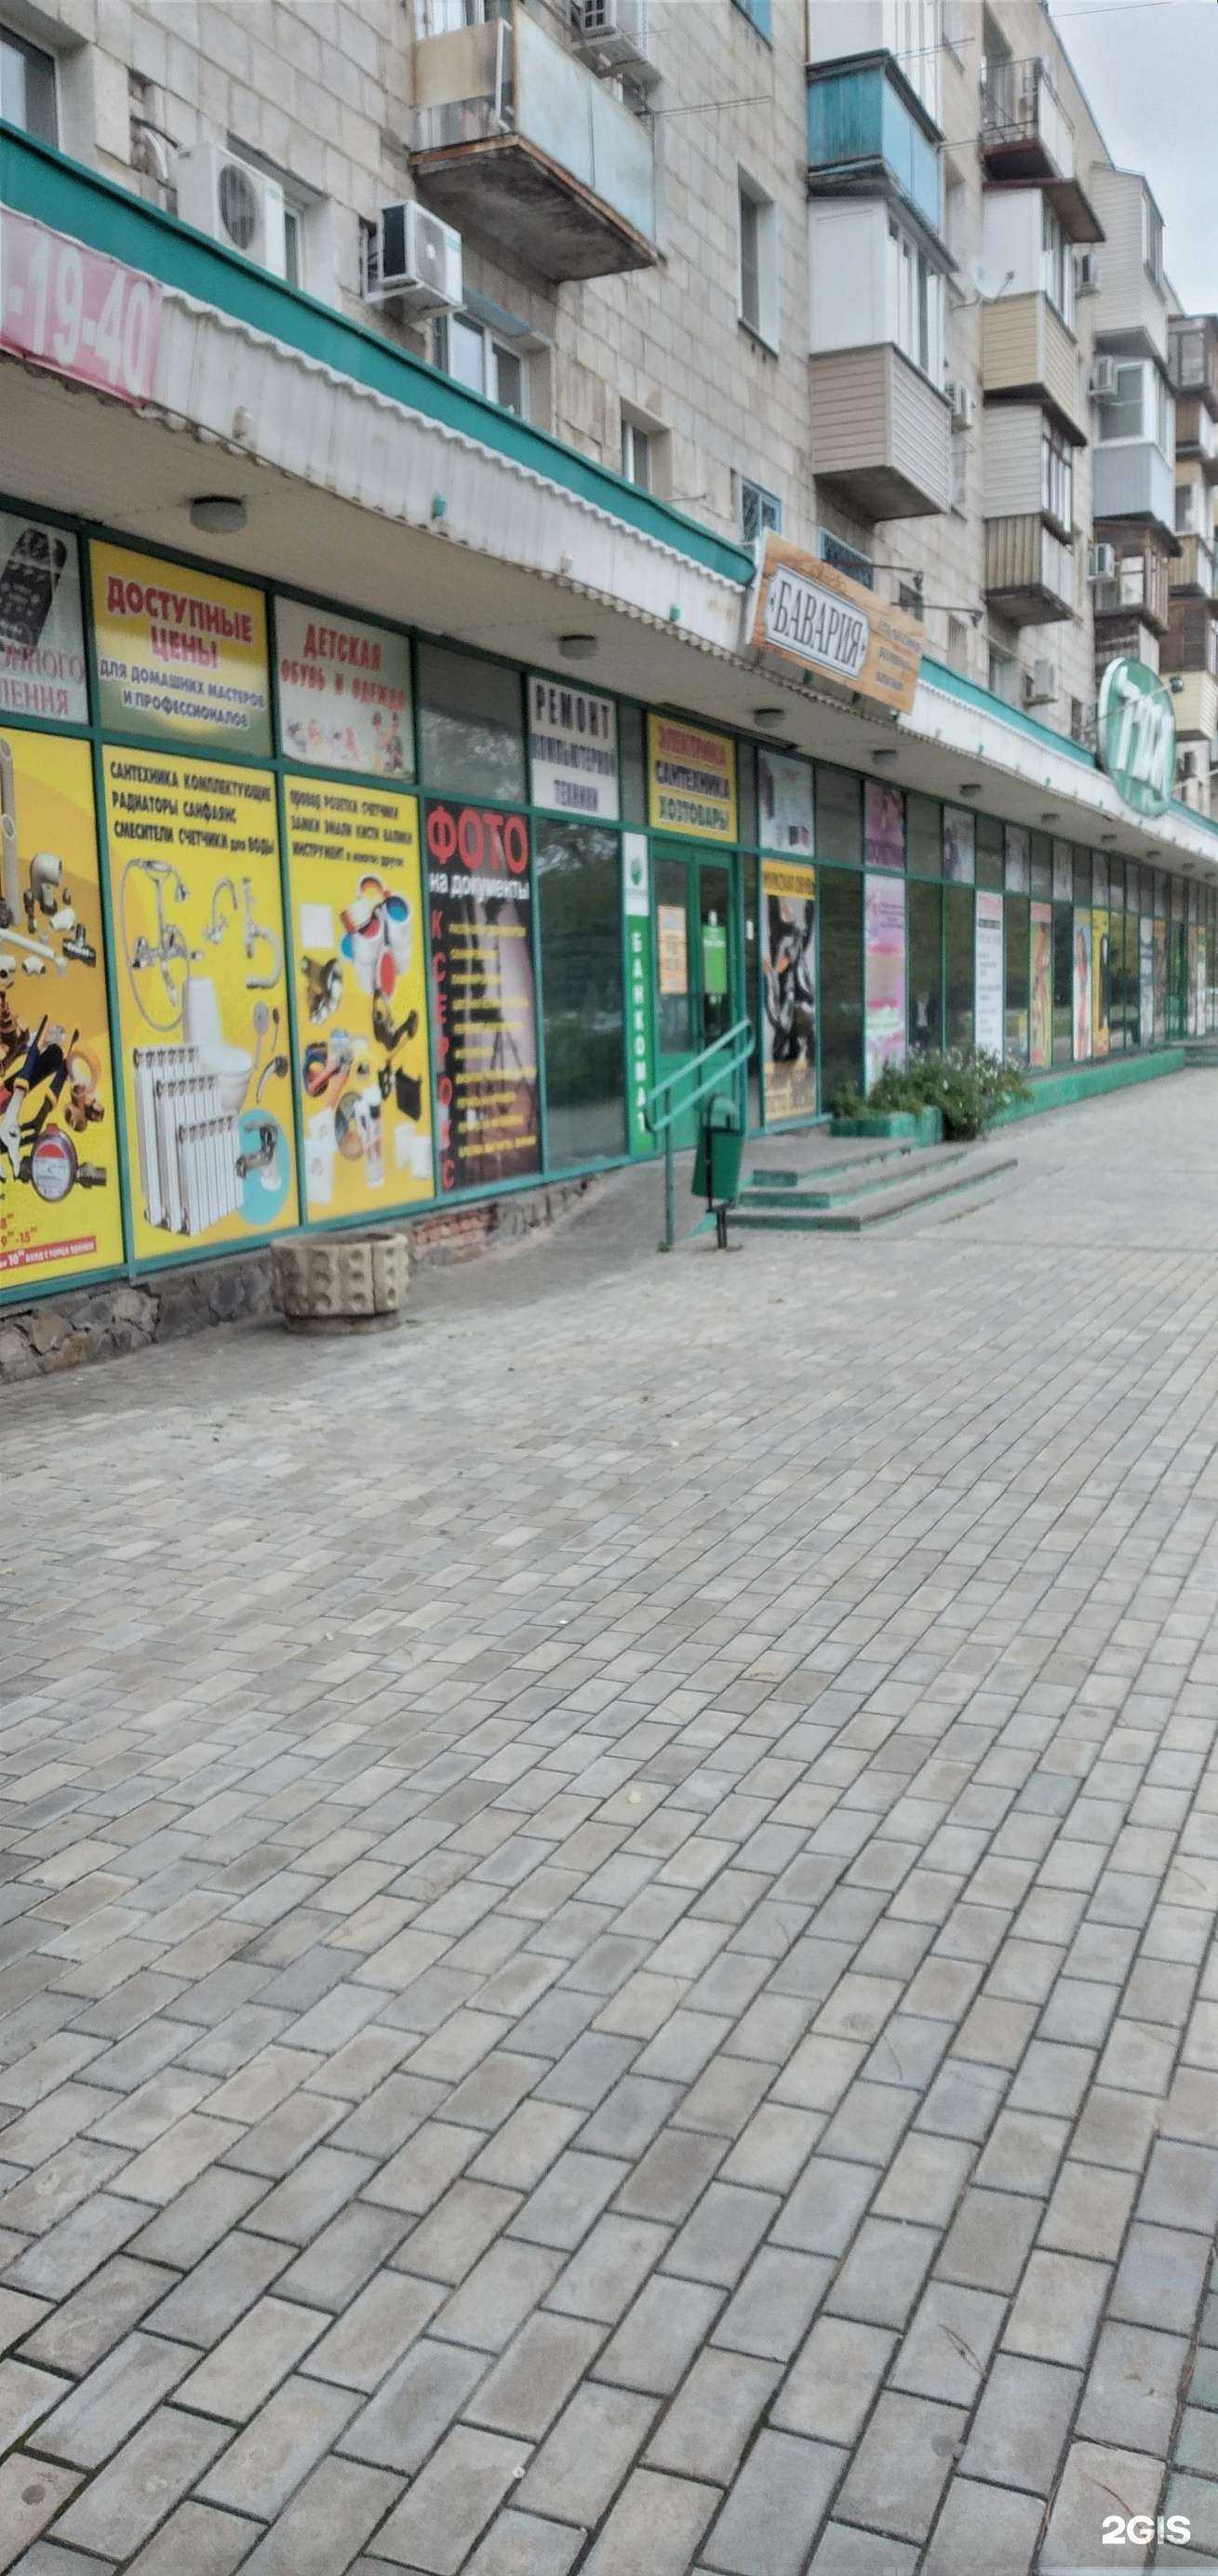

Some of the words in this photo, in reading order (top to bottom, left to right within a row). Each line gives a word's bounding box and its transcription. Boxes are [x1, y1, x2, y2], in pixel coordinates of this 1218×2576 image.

[0, 214, 151, 397] -19-40
[107, 576, 253, 643] ДОСТУПНЫЕ
[773, 580, 863, 668] БАВАРИЯ
[151, 625, 218, 668] ЦЕНЫ
[303, 624, 382, 671] ДЕТСКАЯ
[100, 659, 127, 678] ДЛЯ
[131, 666, 205, 695] ДОМАШНИХ
[207, 683, 265, 707] МАСТЕРОВ
[281, 659, 326, 691] ОБУВЬ
[335, 672, 344, 697] И
[352, 677, 408, 714] ОДЕЖДА
[123, 690, 132, 704] И
[135, 691, 248, 727] ПРОФЕССИОНАЛОВ
[535, 684, 609, 739] РЕМОНТ
[111, 761, 179, 787] САНТЕХНИКА
[112, 791, 178, 815] РАДИАТОРЫ
[114, 821, 173, 843] СМЕСИТЕЛИ
[179, 828, 228, 849] СЧЕТЧИКИ
[427, 805, 529, 874] ФОТО
[429, 871, 448, 893] на
[449, 873, 529, 900] документы
